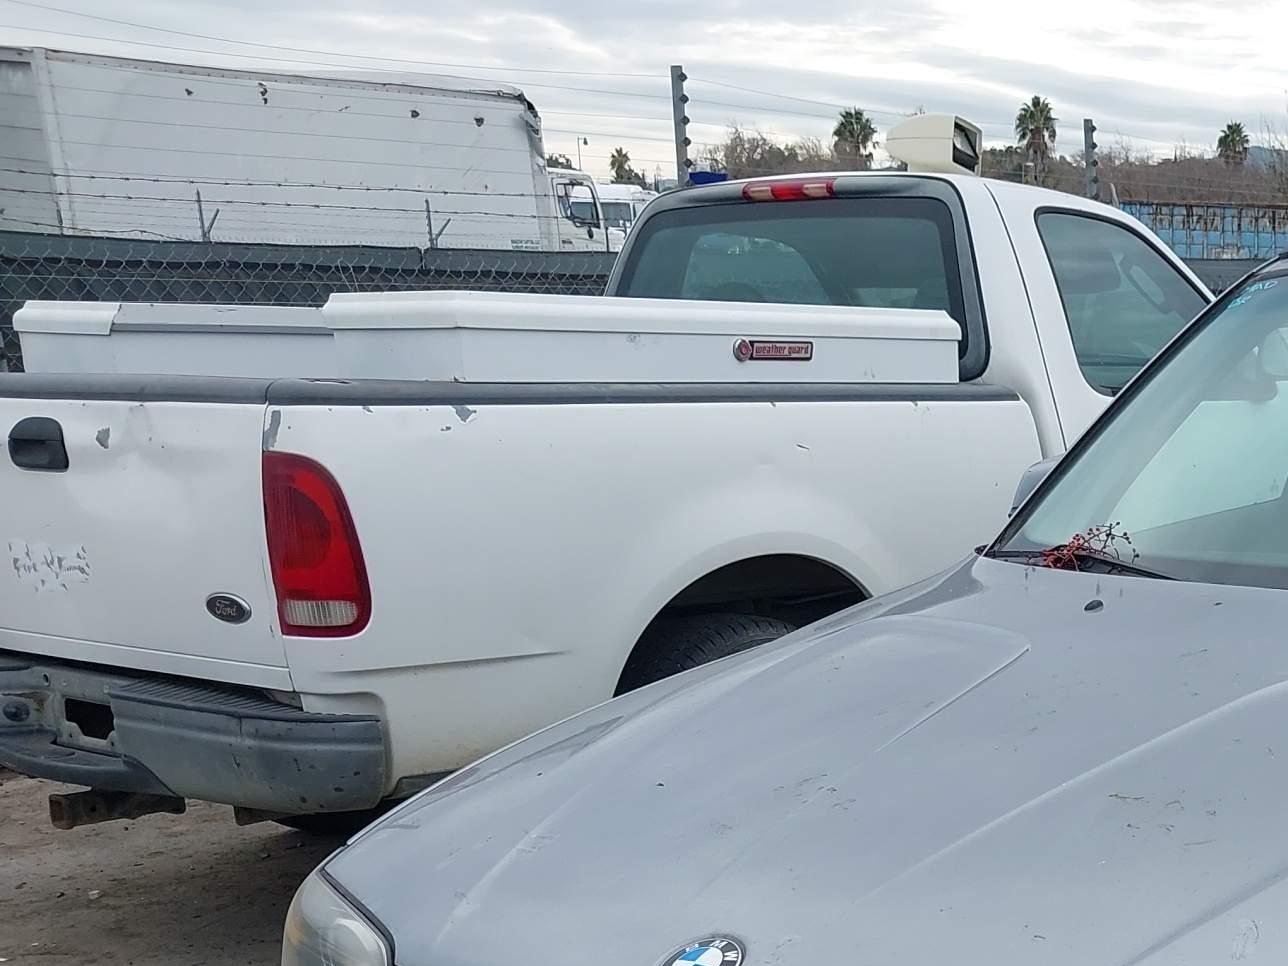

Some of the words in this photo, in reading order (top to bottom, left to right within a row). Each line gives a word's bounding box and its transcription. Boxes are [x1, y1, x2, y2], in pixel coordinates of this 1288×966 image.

[755, 344, 787, 355] weather
[787, 344, 809, 356] guard
[215, 599, 238, 616] Ford
